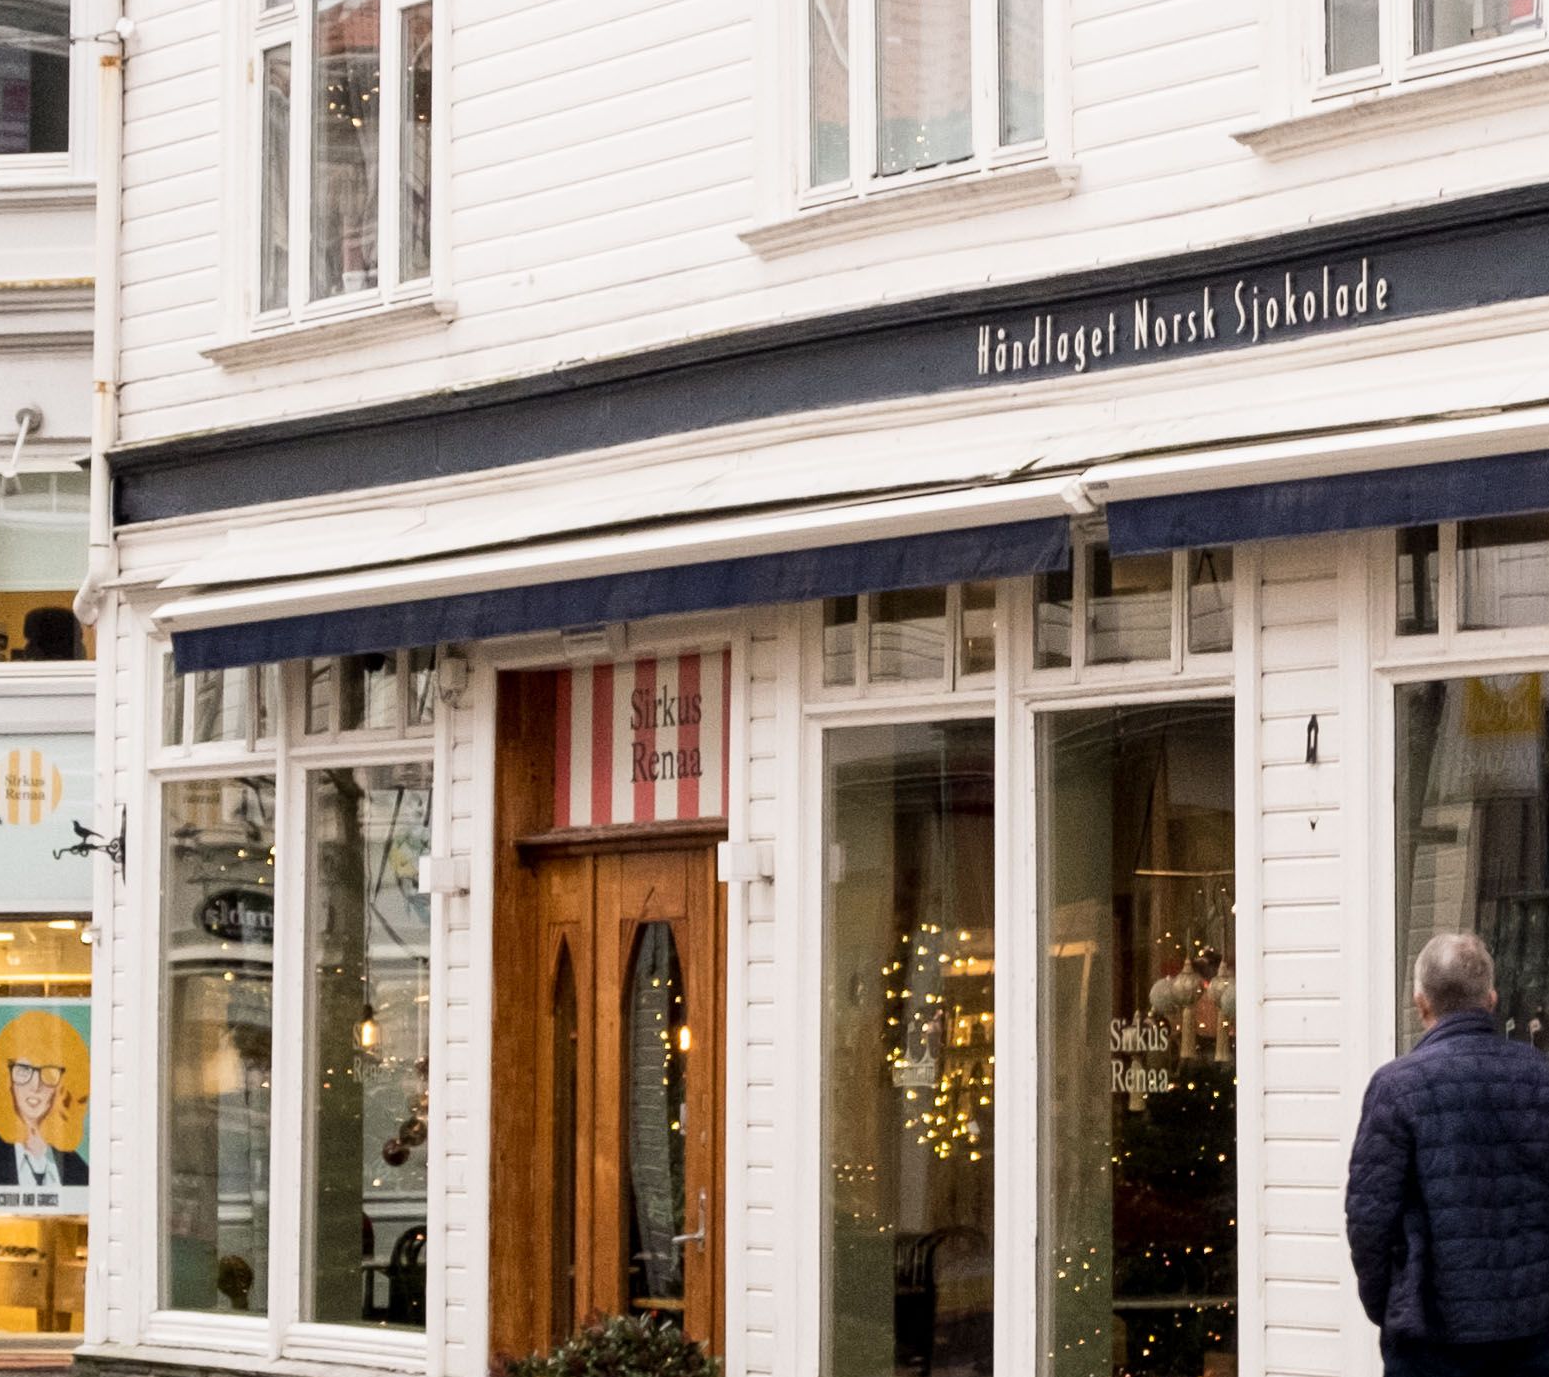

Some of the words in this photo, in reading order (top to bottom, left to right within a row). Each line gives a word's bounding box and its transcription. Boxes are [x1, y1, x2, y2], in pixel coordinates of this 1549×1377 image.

[978, 312, 1115, 375] Håndlaget
[1134, 285, 1215, 351] Norsk
[1236, 257, 1389, 342] Sjokolade
[630, 684, 702, 730] Sirkus
[631, 742, 703, 783] Renaa
[1110, 1017, 1169, 1051] Sirkus
[1111, 1060, 1169, 1093] Renaa
